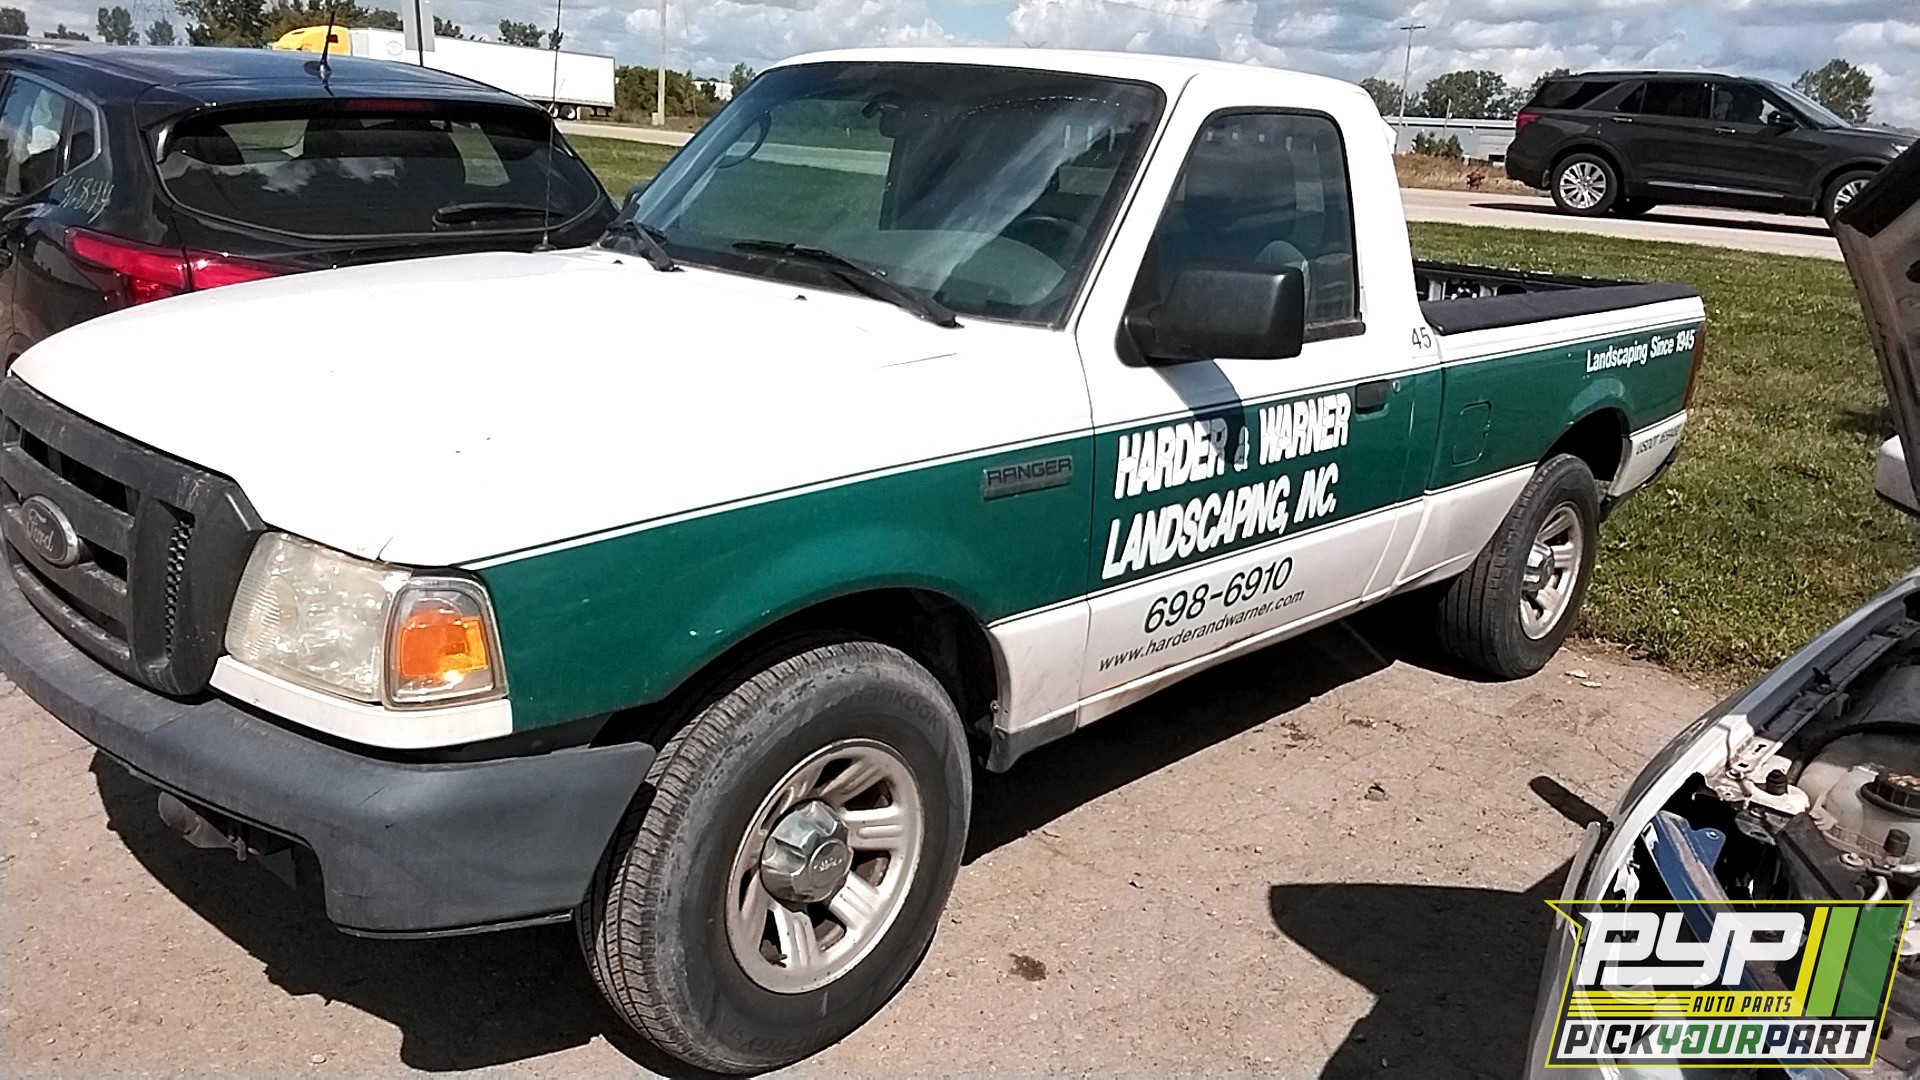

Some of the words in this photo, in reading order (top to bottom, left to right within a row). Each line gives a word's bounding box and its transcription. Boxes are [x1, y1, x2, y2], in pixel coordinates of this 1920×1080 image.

[1411, 327, 1432, 349] 45
[1586, 340, 1648, 373] Landscaping
[1650, 335, 1675, 359] Since
[1675, 329, 1696, 352] 1945
[987, 458, 1073, 486] RANGER
[1114, 417, 1228, 500] HARDER
[1258, 392, 1352, 466] WARNER
[1101, 474, 1291, 581] LANDSCAPING,
[1293, 462, 1339, 524] INC.
[1098, 589, 1306, 672] www.harderandwarner.com
[1143, 556, 1294, 635] 698-6910
